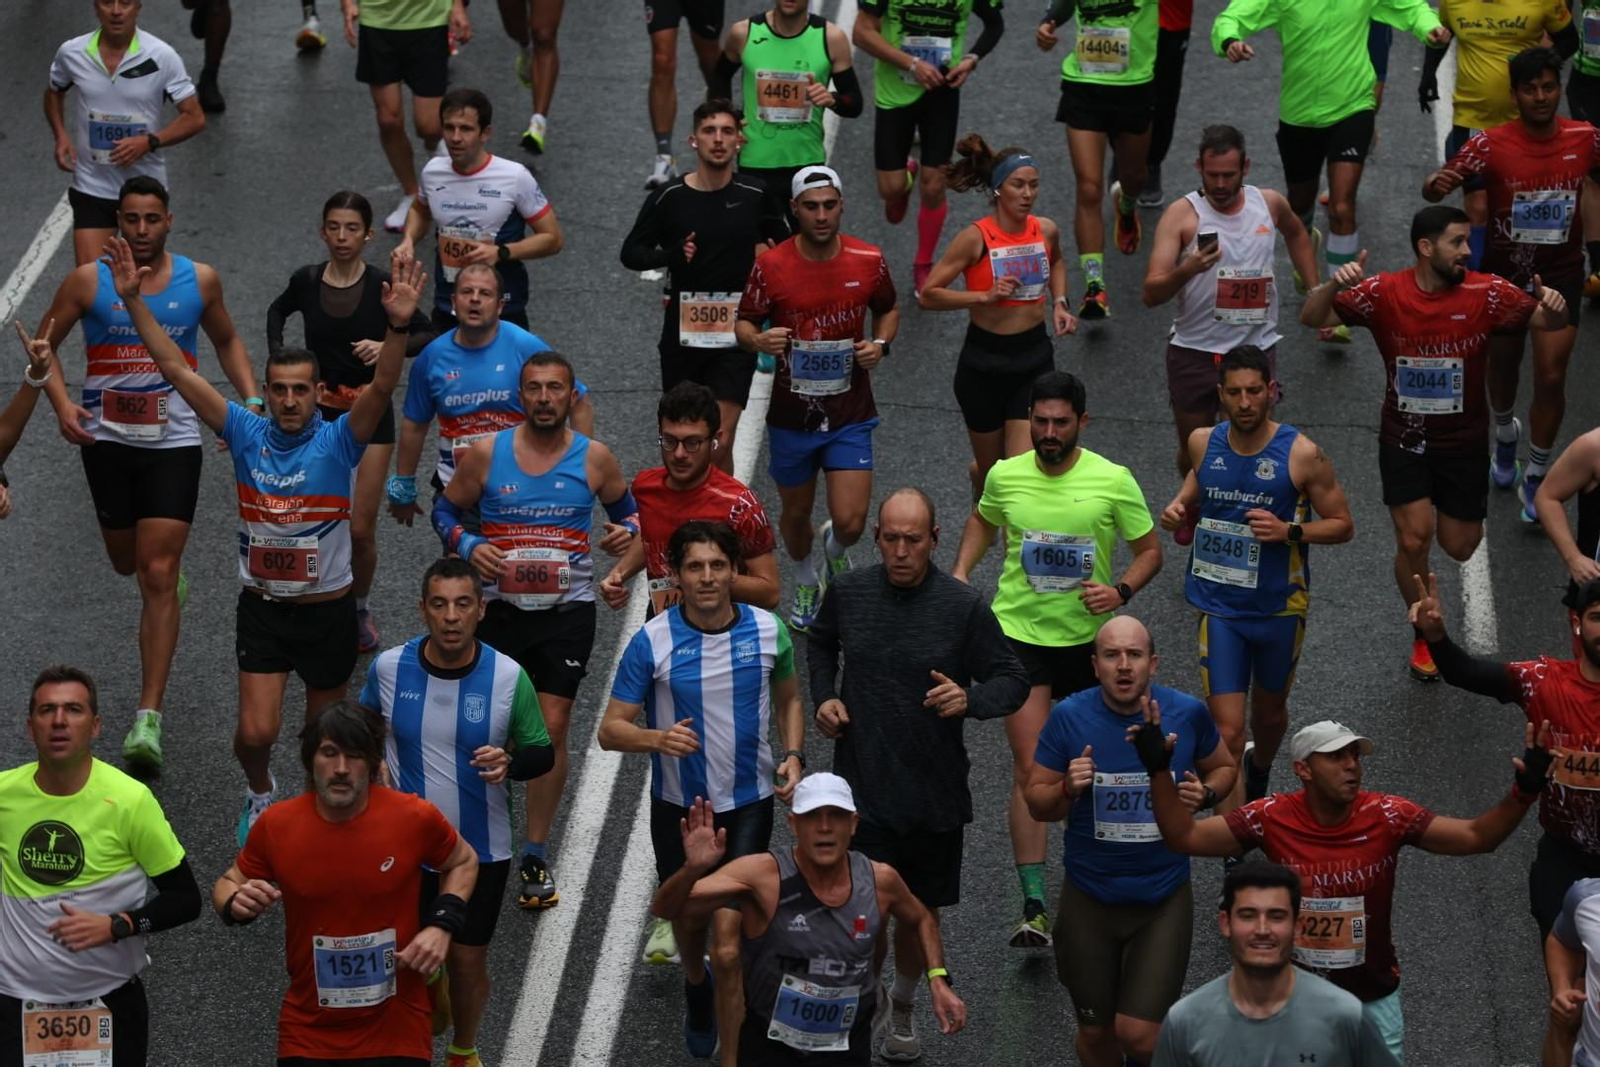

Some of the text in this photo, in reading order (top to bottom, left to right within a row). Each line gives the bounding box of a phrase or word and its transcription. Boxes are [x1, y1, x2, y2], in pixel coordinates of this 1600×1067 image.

[1080, 41, 1120, 54] 14404
[763, 83, 799, 99] 4461
[96, 126, 132, 141] 1691
[444, 241, 477, 258] 454
[1231, 283, 1259, 300] 219
[690, 306, 728, 323] 3508
[801, 354, 840, 372] 2565
[1406, 371, 1448, 389] 2044
[116, 396, 147, 415] 562
[445, 388, 511, 407] enerplus
[1205, 486, 1275, 505] Tirabuzón
[1202, 534, 1244, 558] 2548
[263, 552, 296, 570] 602
[1033, 546, 1077, 568] 1605
[515, 565, 548, 583] 566
[400, 689, 420, 701] vive
[1564, 754, 1600, 776] 444
[1106, 791, 1153, 811] 2878
[23, 847, 78, 870] Sherry
[328, 951, 377, 976] 1521
[791, 998, 839, 1022] 1600
[37, 1015, 91, 1040] 3650
